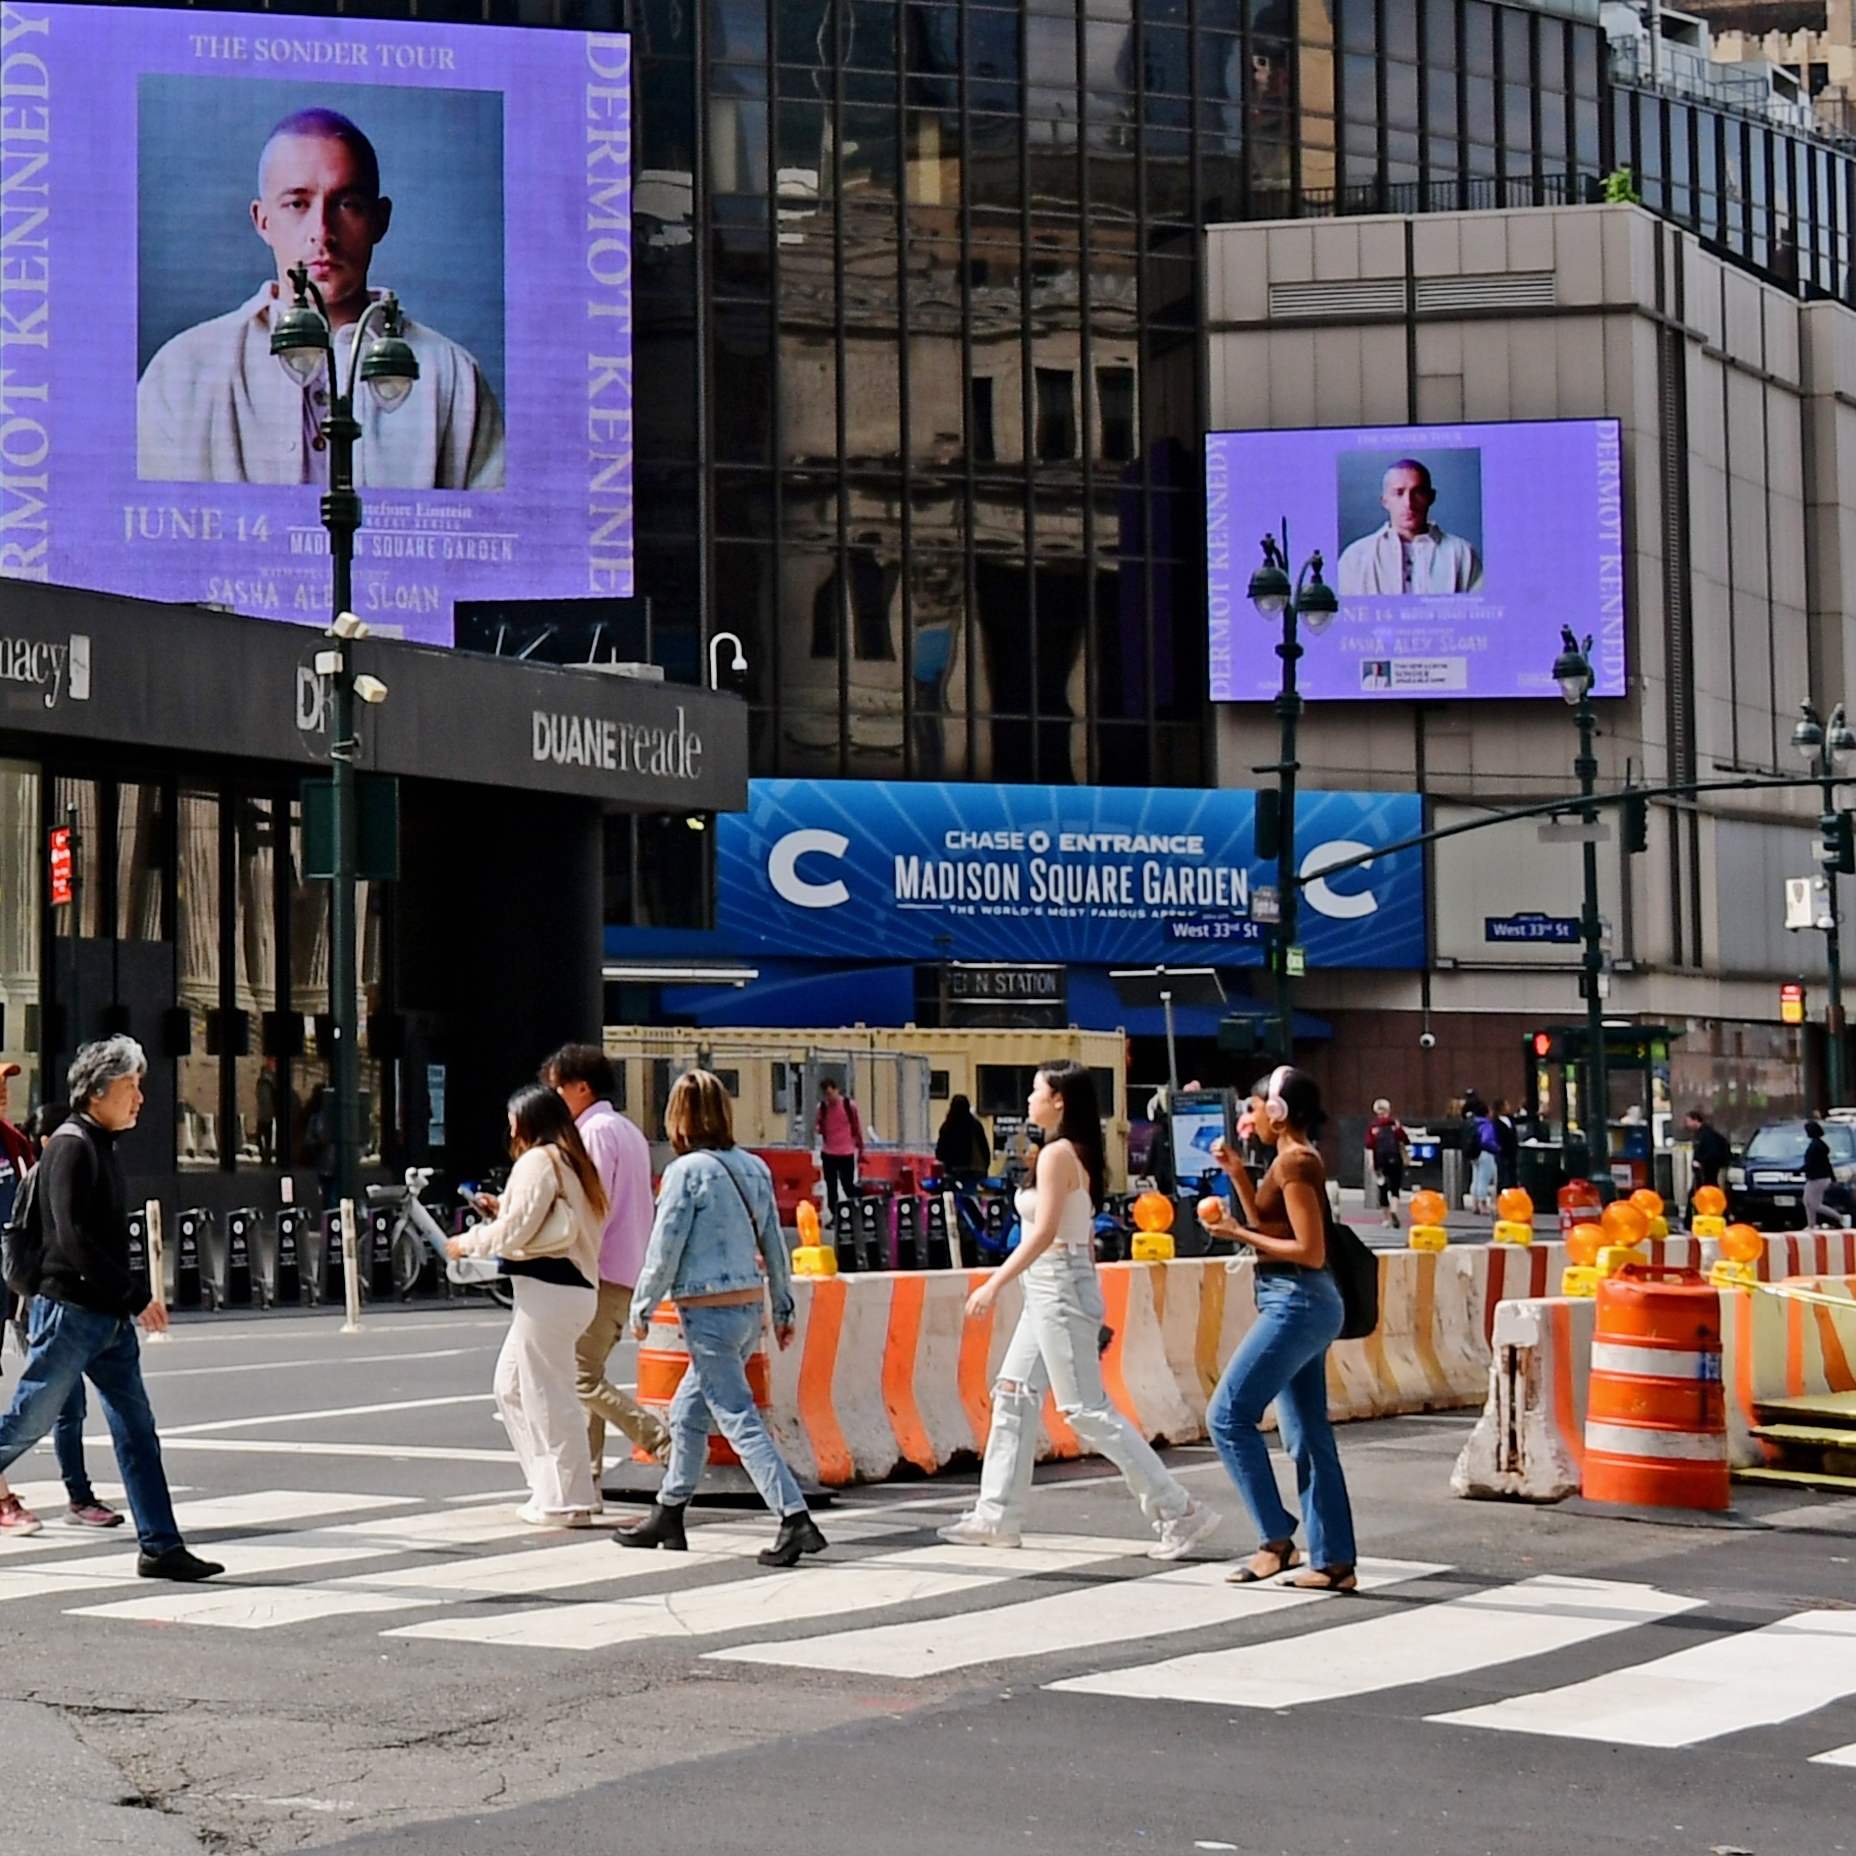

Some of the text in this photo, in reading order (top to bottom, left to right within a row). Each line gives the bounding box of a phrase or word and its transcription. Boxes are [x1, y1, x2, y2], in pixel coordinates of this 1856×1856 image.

[189, 33, 456, 71] THE SONDER TOUR
[0, 3, 50, 348] KENNEDY
[585, 32, 633, 334] DERMOT
[123, 505, 270, 543] JUNE 14
[416, 503, 473, 519] Einstein
[290, 532, 513, 561] MADIN SQUARE GARDEN
[1596, 419, 1626, 692] DERMOT KENNEDY
[1207, 436, 1231, 700] DERMOT KENNEDY
[206, 577, 440, 612] SASHA ALE SLOAN
[1342, 606, 1369, 622] NE
[945, 830, 1205, 855] CHASE ENTRANCE
[895, 854, 1020, 901] MADISON
[1029, 857, 1134, 905] SQUARE
[1142, 860, 1249, 907] GARDEN
[949, 904, 976, 915] THE
[981, 904, 1043, 916] WORLD'S
[1047, 907, 1085, 917] MOST
[1090, 908, 1147, 919] FAMOUS
[1172, 922, 1259, 938] West 33rd St
[1493, 923, 1570, 937] West 33rd St
[995, 972, 1057, 994] STATION
